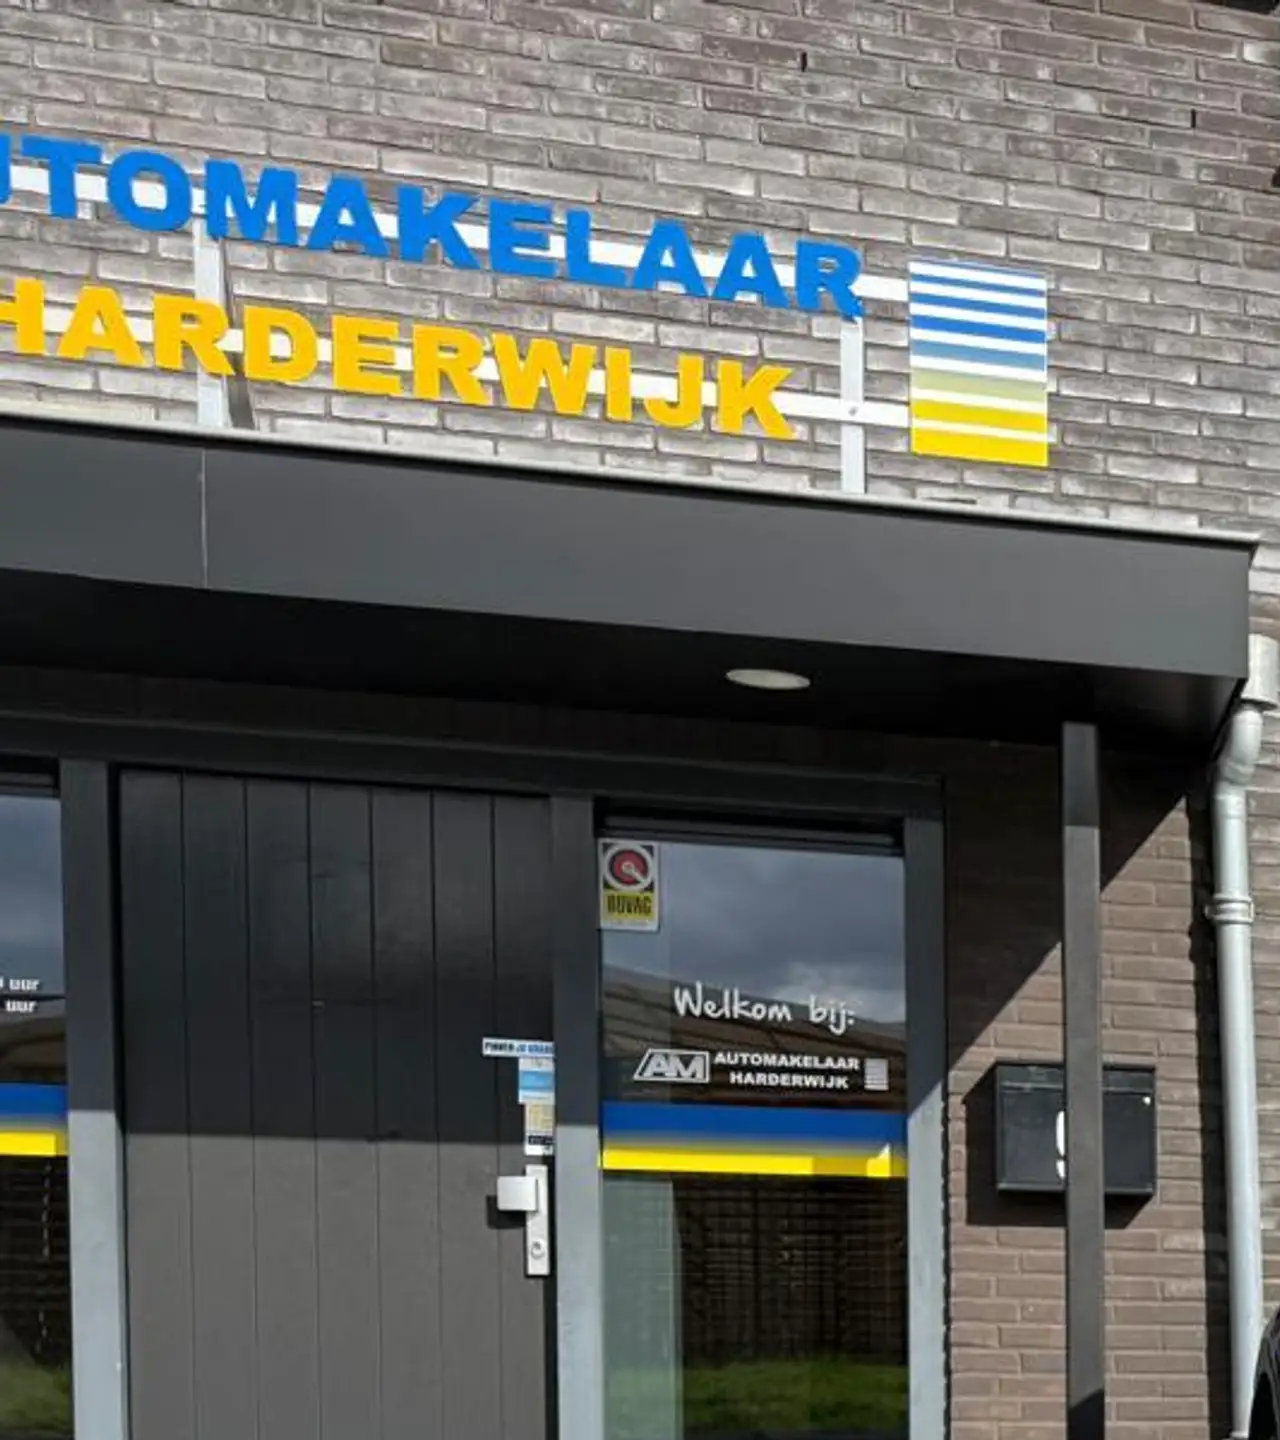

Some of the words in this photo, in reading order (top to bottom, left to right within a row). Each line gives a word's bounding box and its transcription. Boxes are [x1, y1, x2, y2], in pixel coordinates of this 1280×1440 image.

[0, 134, 865, 320] TOMAKELAAR
[0, 279, 795, 441] HARDERWIJK
[674, 981, 792, 1022] Welkom
[809, 995, 855, 1036] bij:
[643, 1055, 704, 1079] AM
[714, 1053, 859, 1070] AUTOMAKELAAR
[730, 1073, 849, 1089] HARDERWIJK
